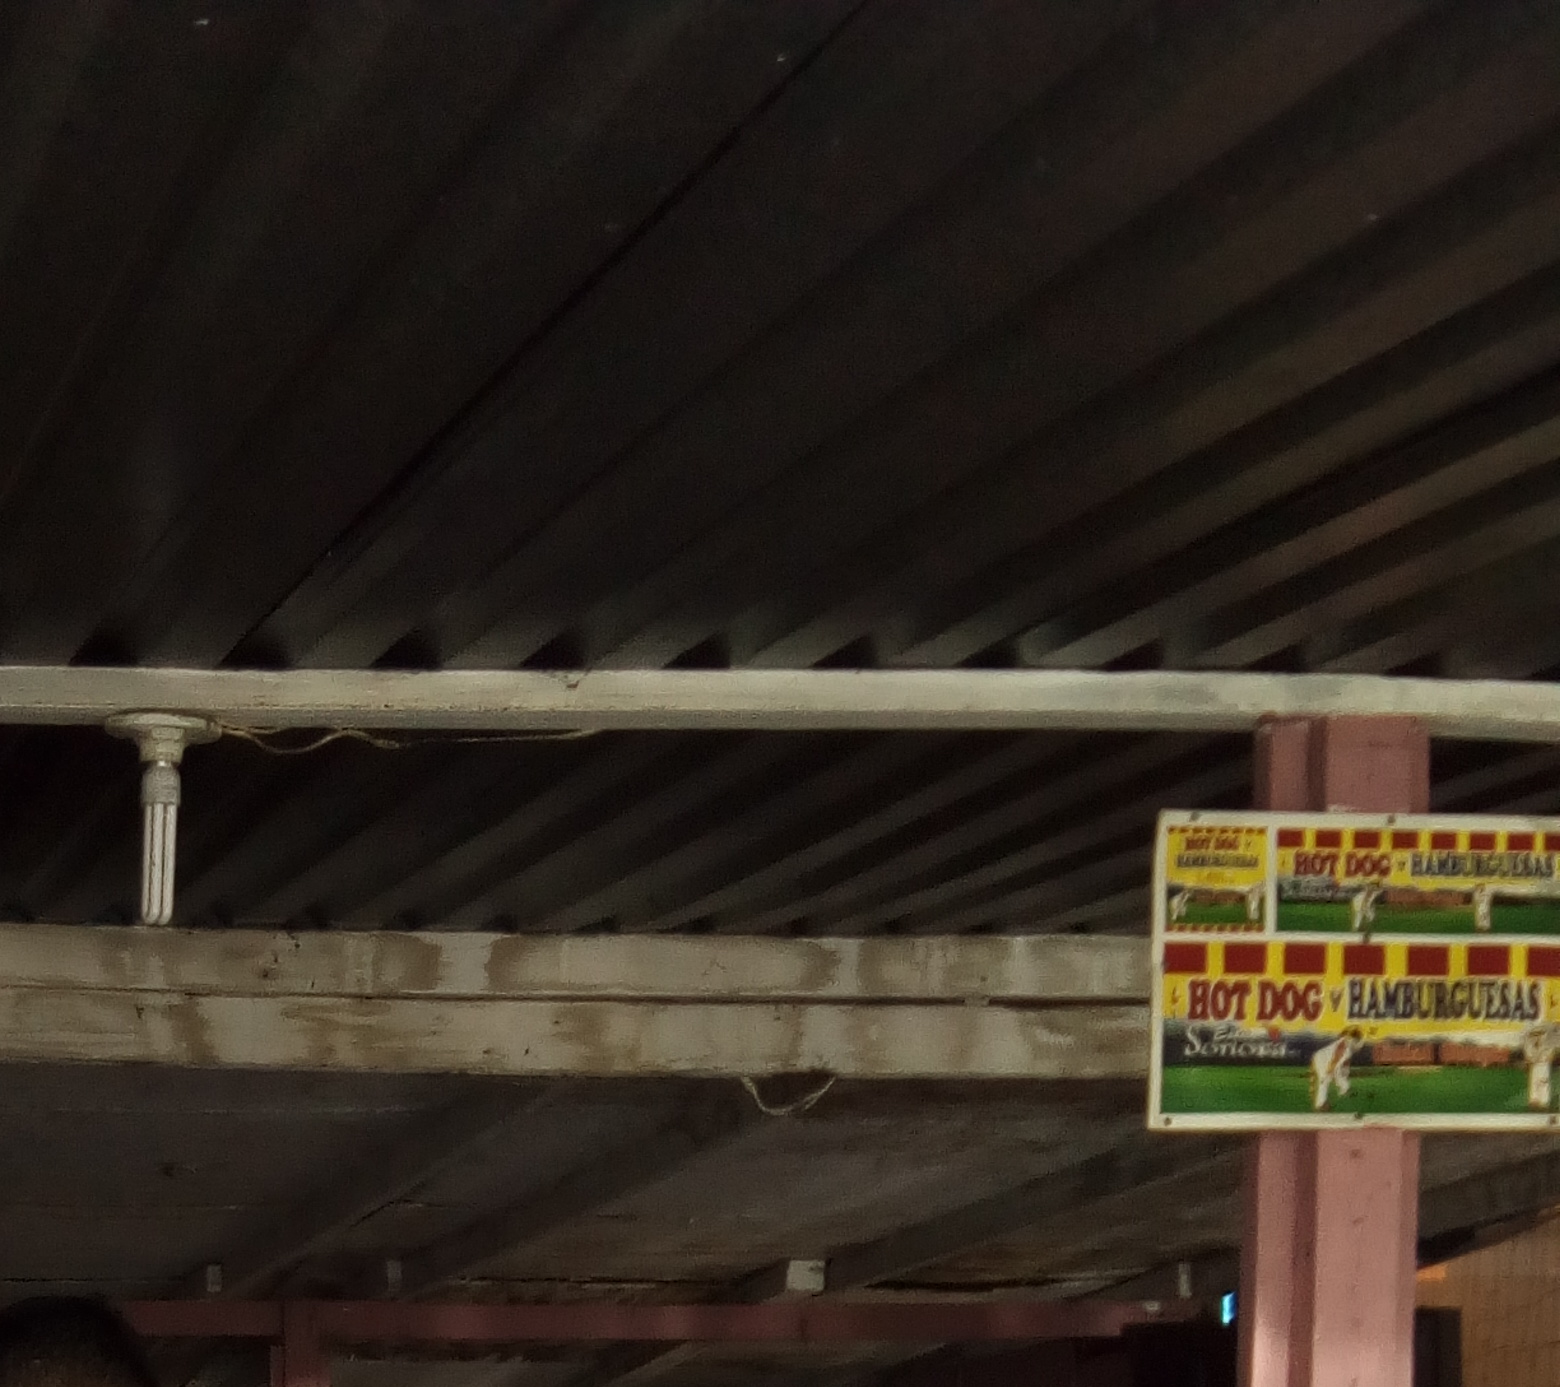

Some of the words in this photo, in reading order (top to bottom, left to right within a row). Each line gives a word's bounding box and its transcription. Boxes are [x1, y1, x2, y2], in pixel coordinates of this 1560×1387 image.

[1293, 852, 1338, 876] HOT
[1345, 852, 1391, 876] DOG
[1410, 852, 1553, 876] HAMBURGUESAS
[1187, 979, 1250, 1021] HOT
[1256, 980, 1323, 1021] DOG
[1346, 978, 1540, 1021] HAMBURGUESAS
